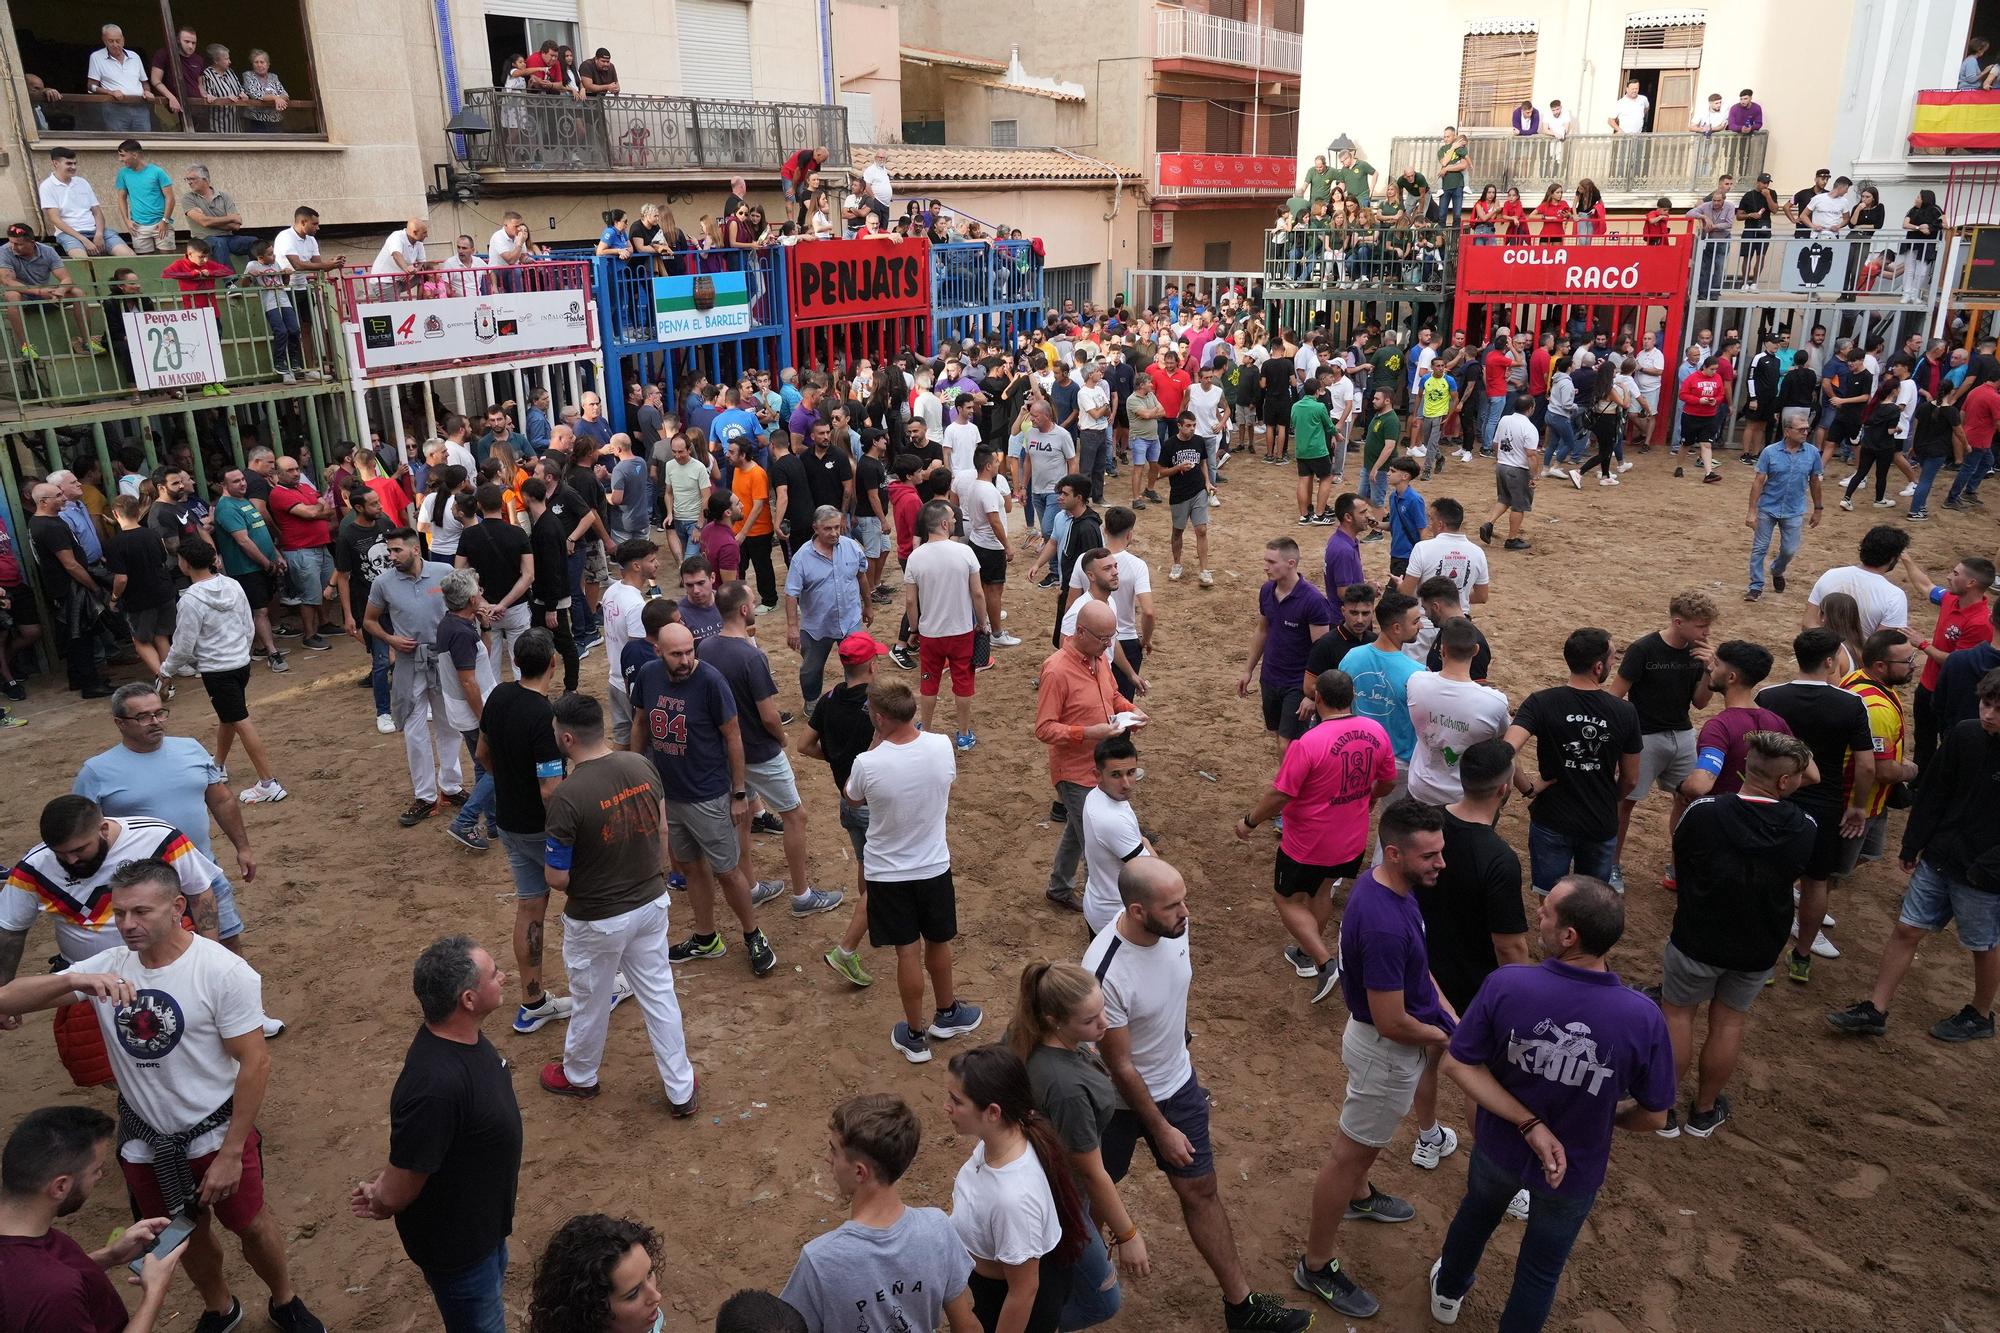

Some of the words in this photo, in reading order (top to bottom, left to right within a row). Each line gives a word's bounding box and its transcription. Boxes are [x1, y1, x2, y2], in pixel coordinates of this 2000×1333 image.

[1503, 249, 1567, 264] COLLA
[801, 256, 918, 306] PENJATS
[1565, 262, 1639, 288] RACÓ
[144, 313, 178, 326] Penya
[181, 311, 198, 321] els
[658, 319, 689, 334] PENYA
[693, 318, 702, 330] EL
[705, 312, 747, 328] BARRILET
[147, 326, 183, 372] 20
[158, 371, 207, 387] ALMASSORA
[1029, 441, 1053, 451] FILA
[656, 695, 686, 712] NYC
[649, 708, 687, 743] 84
[1566, 714, 1607, 728] COLLA
[1565, 760, 1577, 768] EL
[600, 800, 612, 810] la
[612, 782, 651, 806] galbana
[856, 1279, 922, 1313] PEÑA
